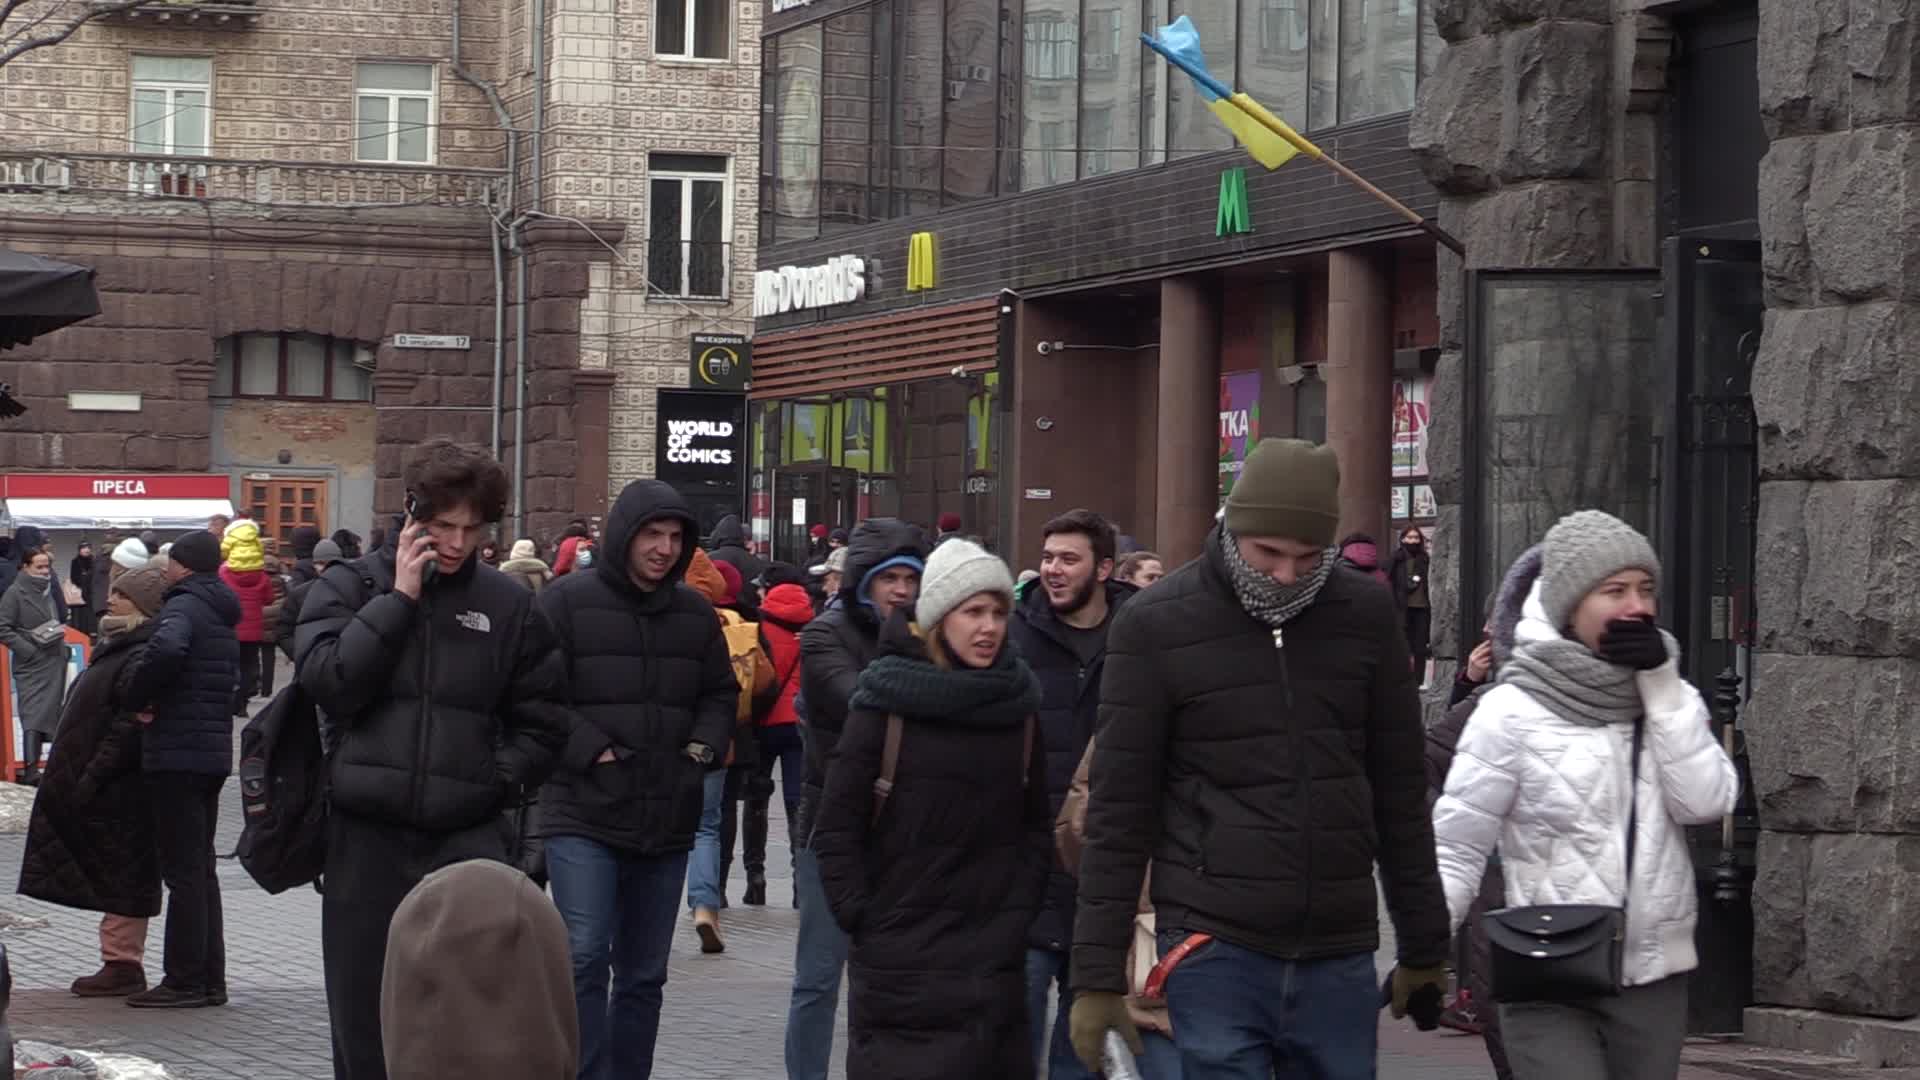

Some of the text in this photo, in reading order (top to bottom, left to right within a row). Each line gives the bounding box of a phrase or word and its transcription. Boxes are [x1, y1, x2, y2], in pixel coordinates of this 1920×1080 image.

[753, 254, 866, 317] McDonald's
[455, 336, 467, 346] 17
[667, 420, 733, 436] WORLD
[667, 435, 692, 448] OF
[667, 449, 732, 464] COMICS
[93, 480, 146, 494] ПРЕСА
